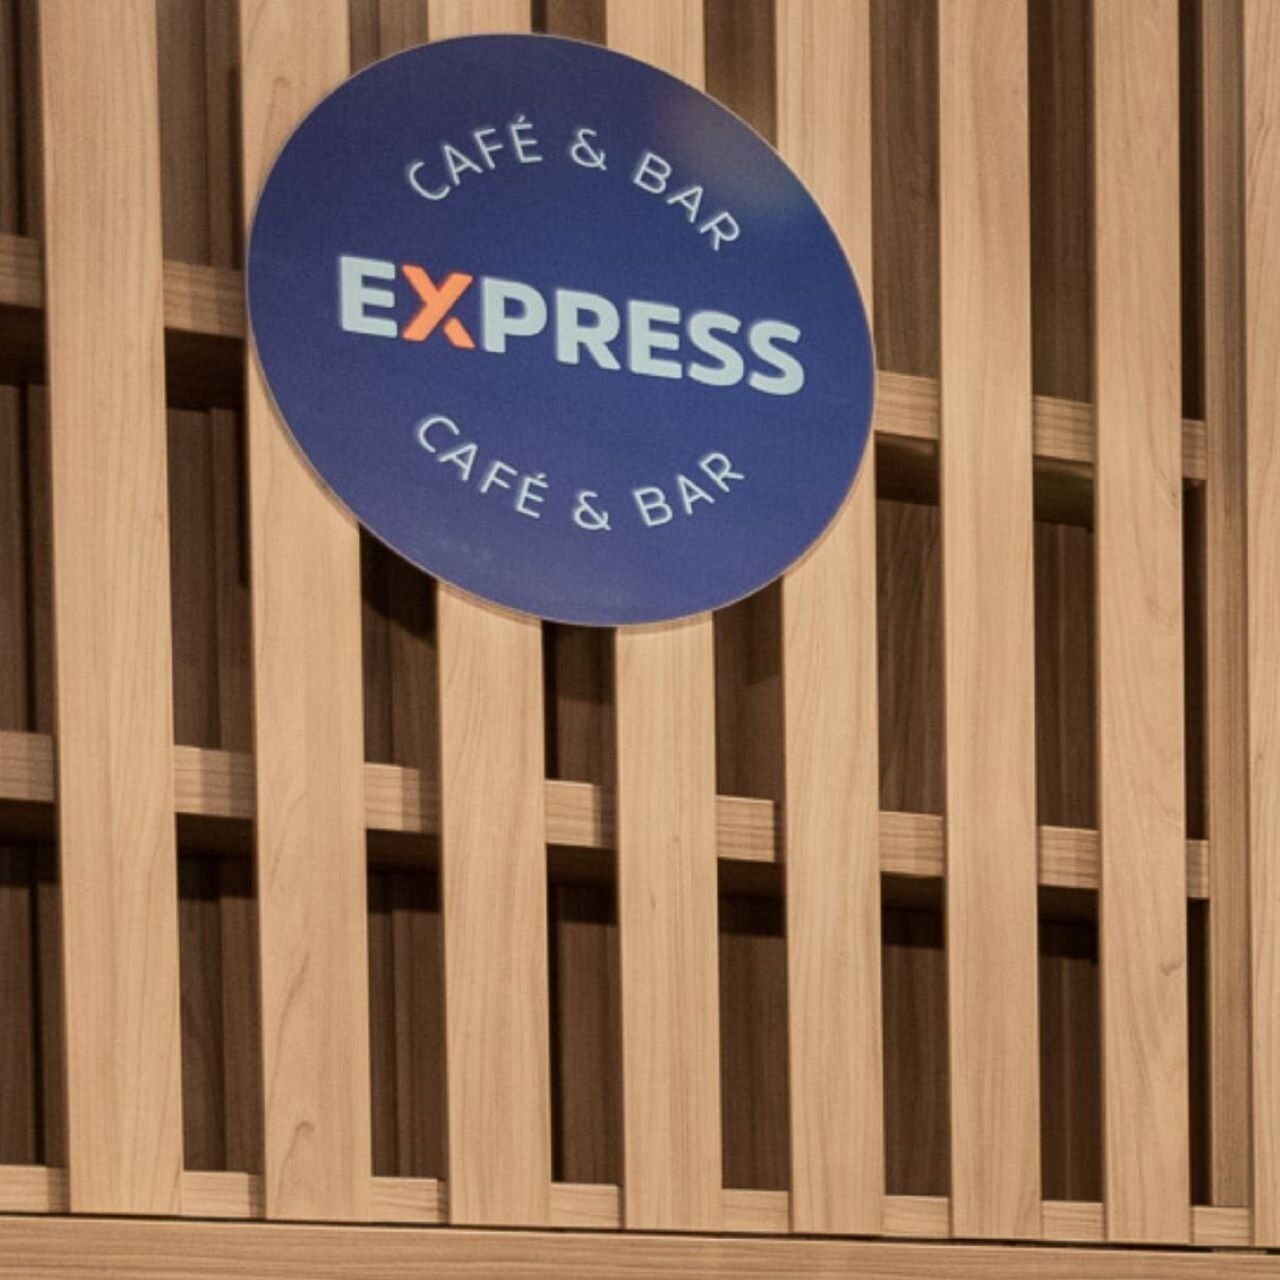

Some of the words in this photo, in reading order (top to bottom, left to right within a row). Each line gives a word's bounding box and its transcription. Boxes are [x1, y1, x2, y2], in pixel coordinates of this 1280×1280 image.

[408, 115, 543, 201] CAFÉ
[569, 127, 608, 171] &
[632, 152, 741, 251] BAR
[338, 254, 805, 396] EXPRESS
[416, 414, 550, 519] CAFÉ
[573, 491, 612, 532] &
[633, 450, 745, 528] BAR
